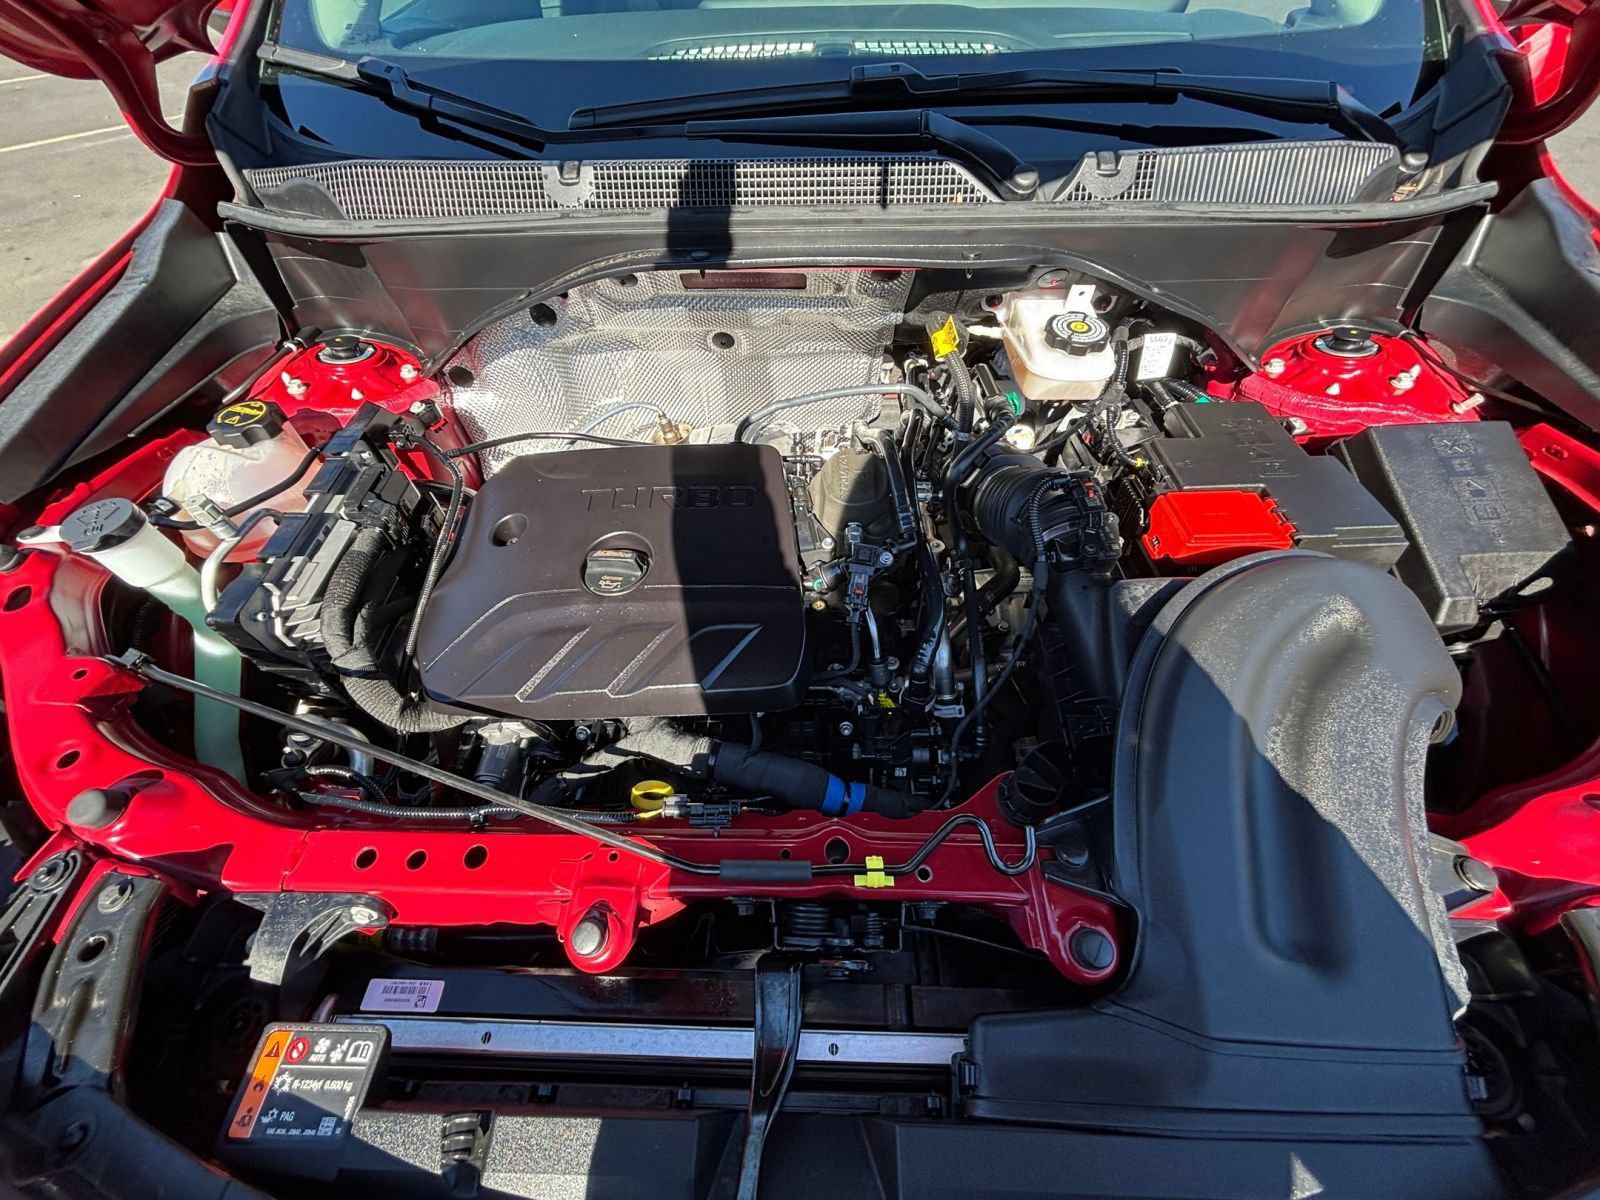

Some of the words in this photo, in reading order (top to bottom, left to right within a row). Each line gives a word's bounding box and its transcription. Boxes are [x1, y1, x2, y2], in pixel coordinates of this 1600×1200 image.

[580, 486, 758, 511] TURBO
[309, 1054, 326, 1062] AUTO
[292, 1079, 323, 1092] R-1234yf
[342, 1080, 353, 1092] kg
[280, 1111, 295, 1121] PAG
